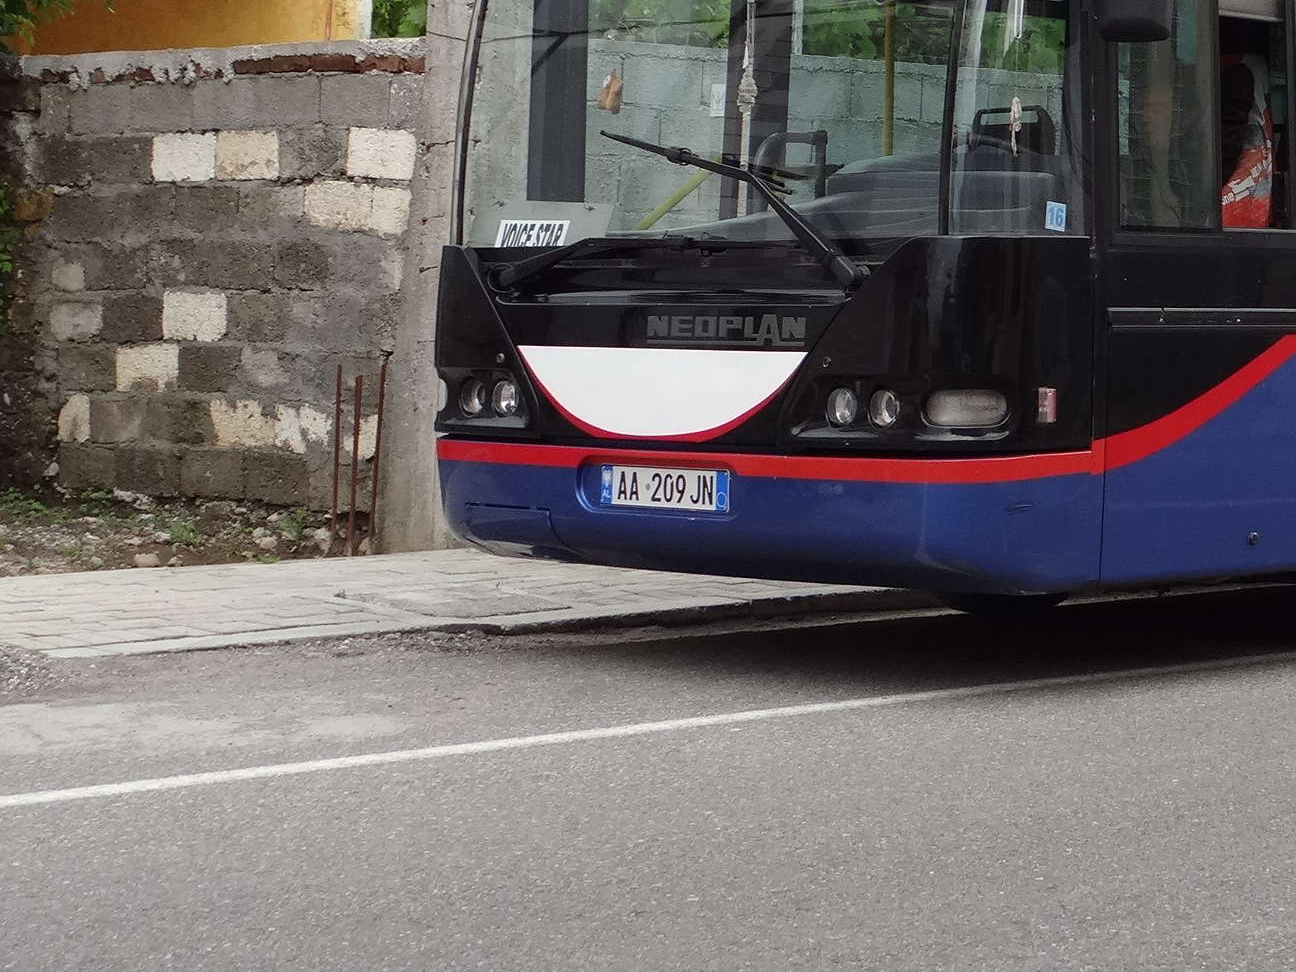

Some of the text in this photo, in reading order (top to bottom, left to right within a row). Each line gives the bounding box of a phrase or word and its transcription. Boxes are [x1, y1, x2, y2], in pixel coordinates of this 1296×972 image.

[1048, 206, 1064, 227] 16
[501, 223, 565, 247] VOICE STAR
[646, 314, 807, 345] NEOPLAN
[617, 471, 714, 505] AA 209 JN
